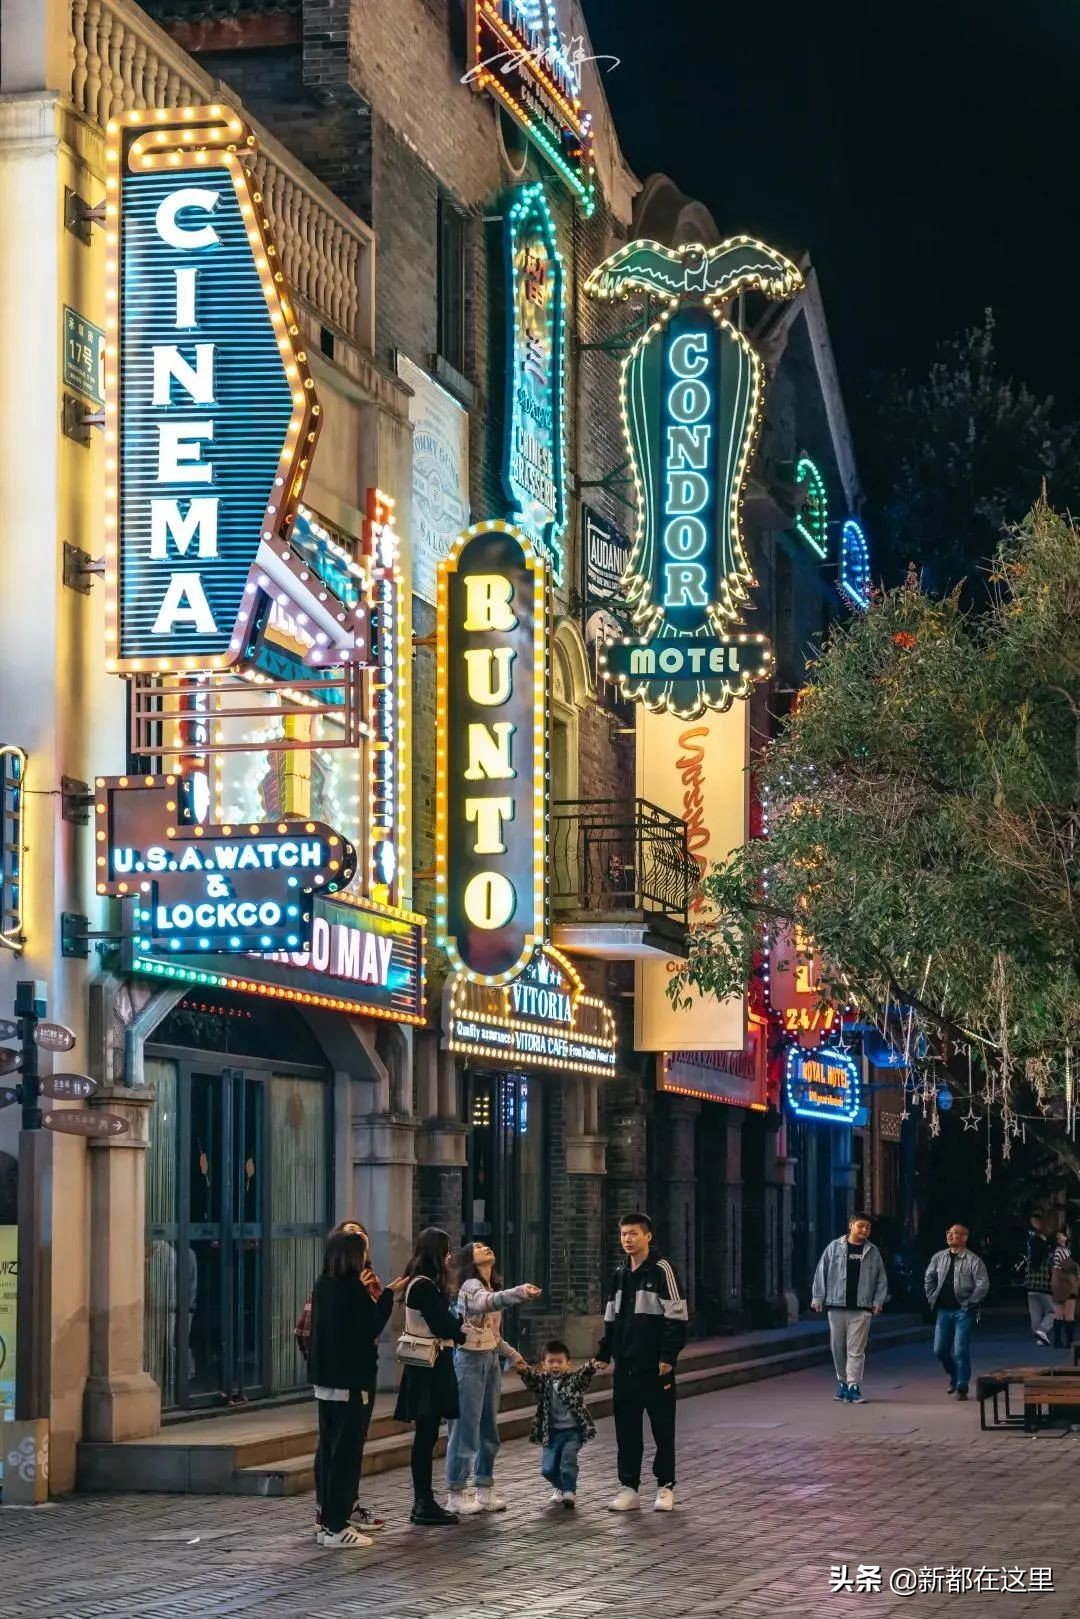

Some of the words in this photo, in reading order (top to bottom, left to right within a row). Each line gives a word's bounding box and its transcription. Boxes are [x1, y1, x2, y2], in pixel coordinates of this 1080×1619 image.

[69, 338, 94, 373] 17号
[150, 186, 223, 635] CINEMA
[415, 434, 437, 458] OMMY
[664, 332, 711, 607] CONDOR
[630, 646, 740, 676] MOTEL
[463, 573, 517, 932] BUNTO
[206, 874, 229, 898] &
[156, 901, 281, 930] LOCKCO
[337, 925, 393, 987] MAY
[512, 983, 572, 1022] VITORIA
[786, 1008, 835, 1031] 24/7
[456, 1021, 480, 1042] Quality
[514, 1030, 546, 1054] VITORIA
[548, 1037, 568, 1058] CAFE
